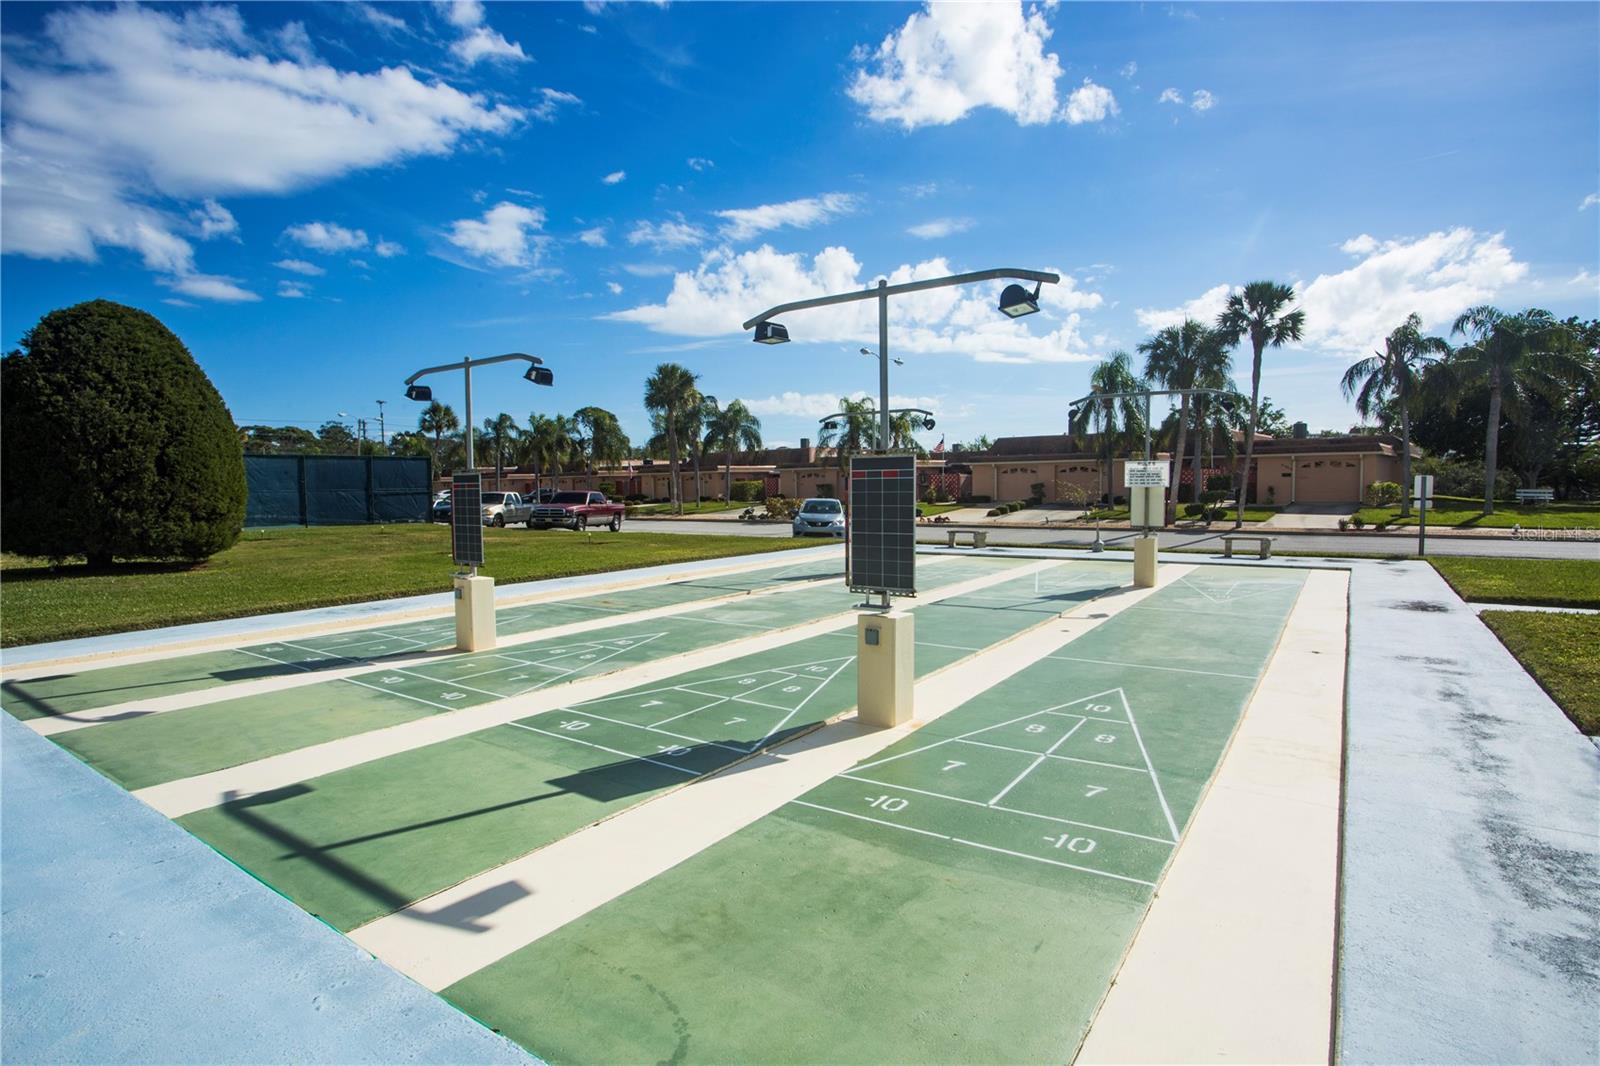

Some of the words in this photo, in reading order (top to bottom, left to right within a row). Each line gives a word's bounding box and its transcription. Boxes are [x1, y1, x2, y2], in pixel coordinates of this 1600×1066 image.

[640, 699, 664, 708] 7
[1084, 703, 1112, 713] 10
[559, 719, 592, 731] -10
[723, 716, 747, 726] 7
[1024, 723, 1047, 734] 8
[1094, 733, 1117, 744] 8
[942, 759, 967, 771] 7
[1084, 784, 1109, 797] 7
[864, 795, 909, 812] -10
[1043, 833, 1097, 854] -10
